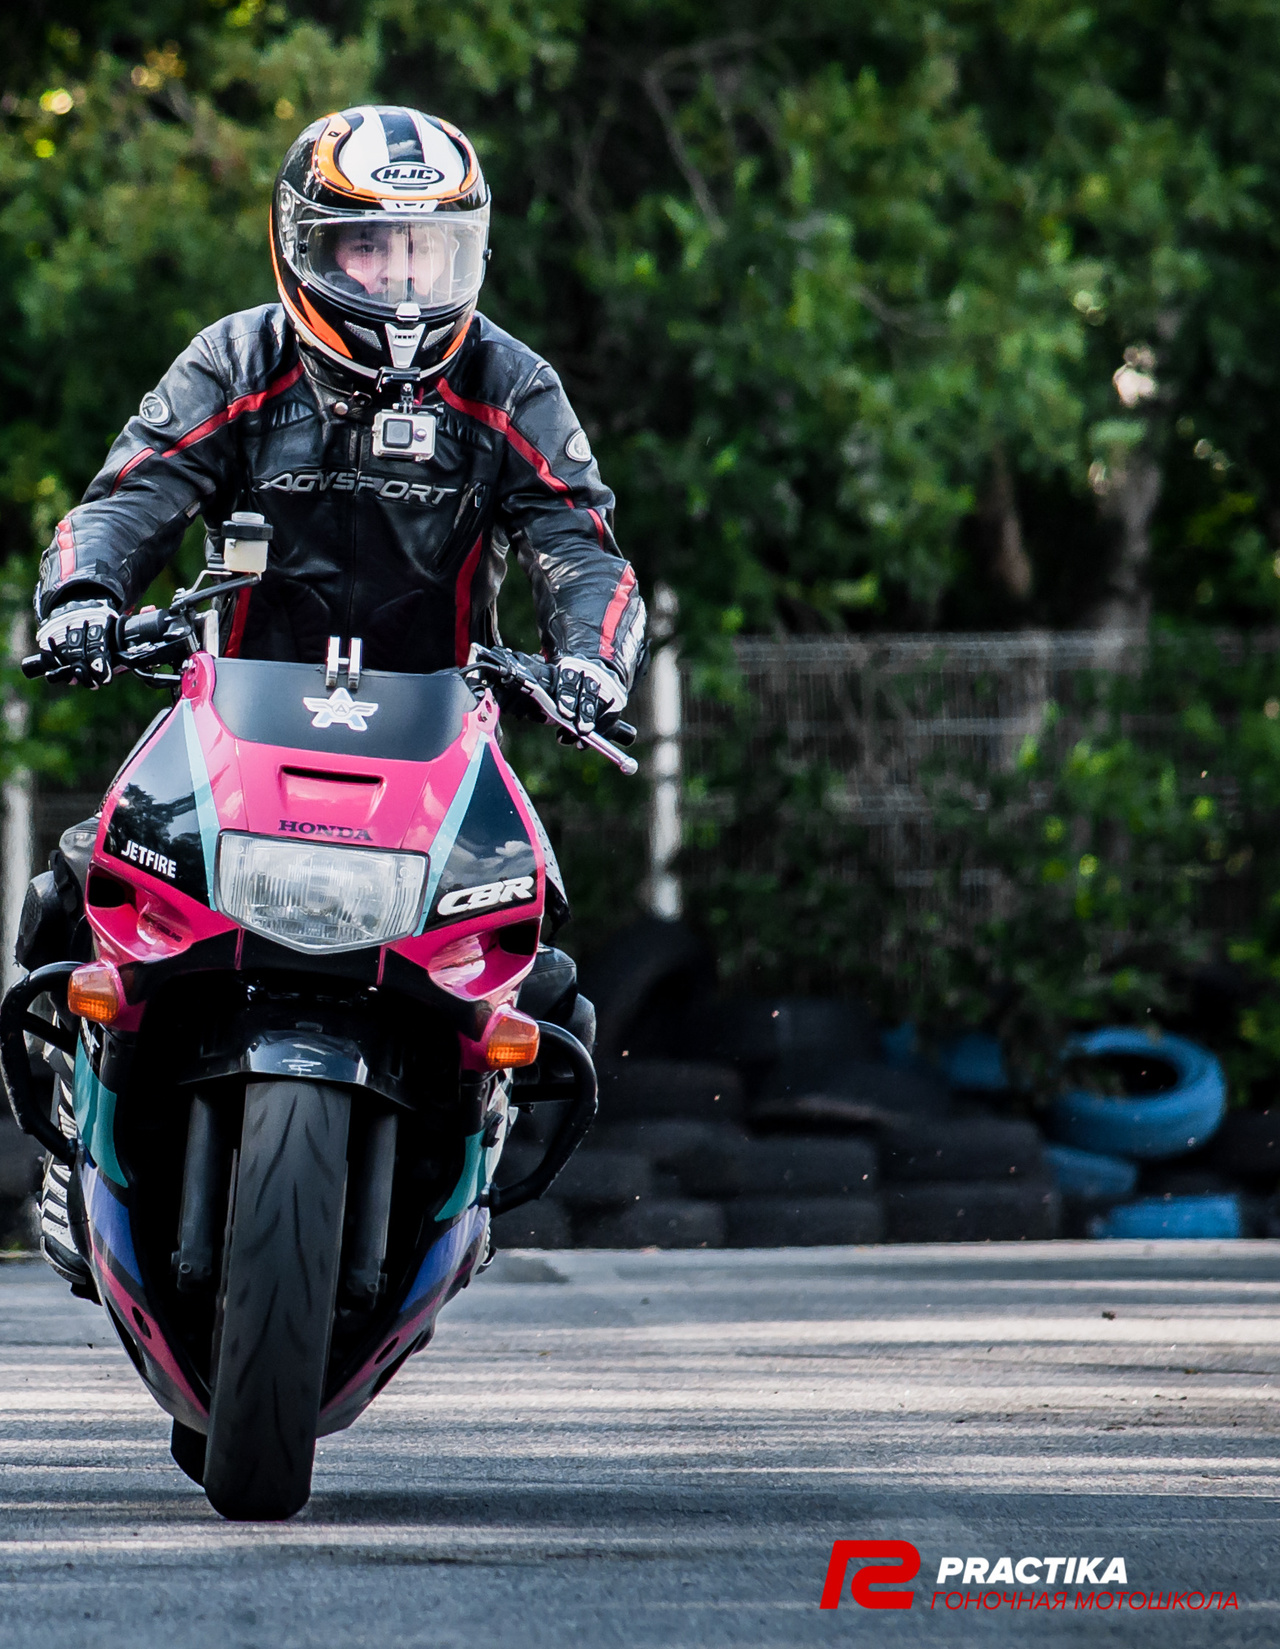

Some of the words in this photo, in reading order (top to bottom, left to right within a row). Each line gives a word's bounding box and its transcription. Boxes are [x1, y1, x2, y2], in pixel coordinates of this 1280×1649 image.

[383, 169, 433, 179] HJC
[278, 819, 373, 841] HONDA
[121, 840, 177, 879] JETFIRE
[437, 876, 534, 915] CBR
